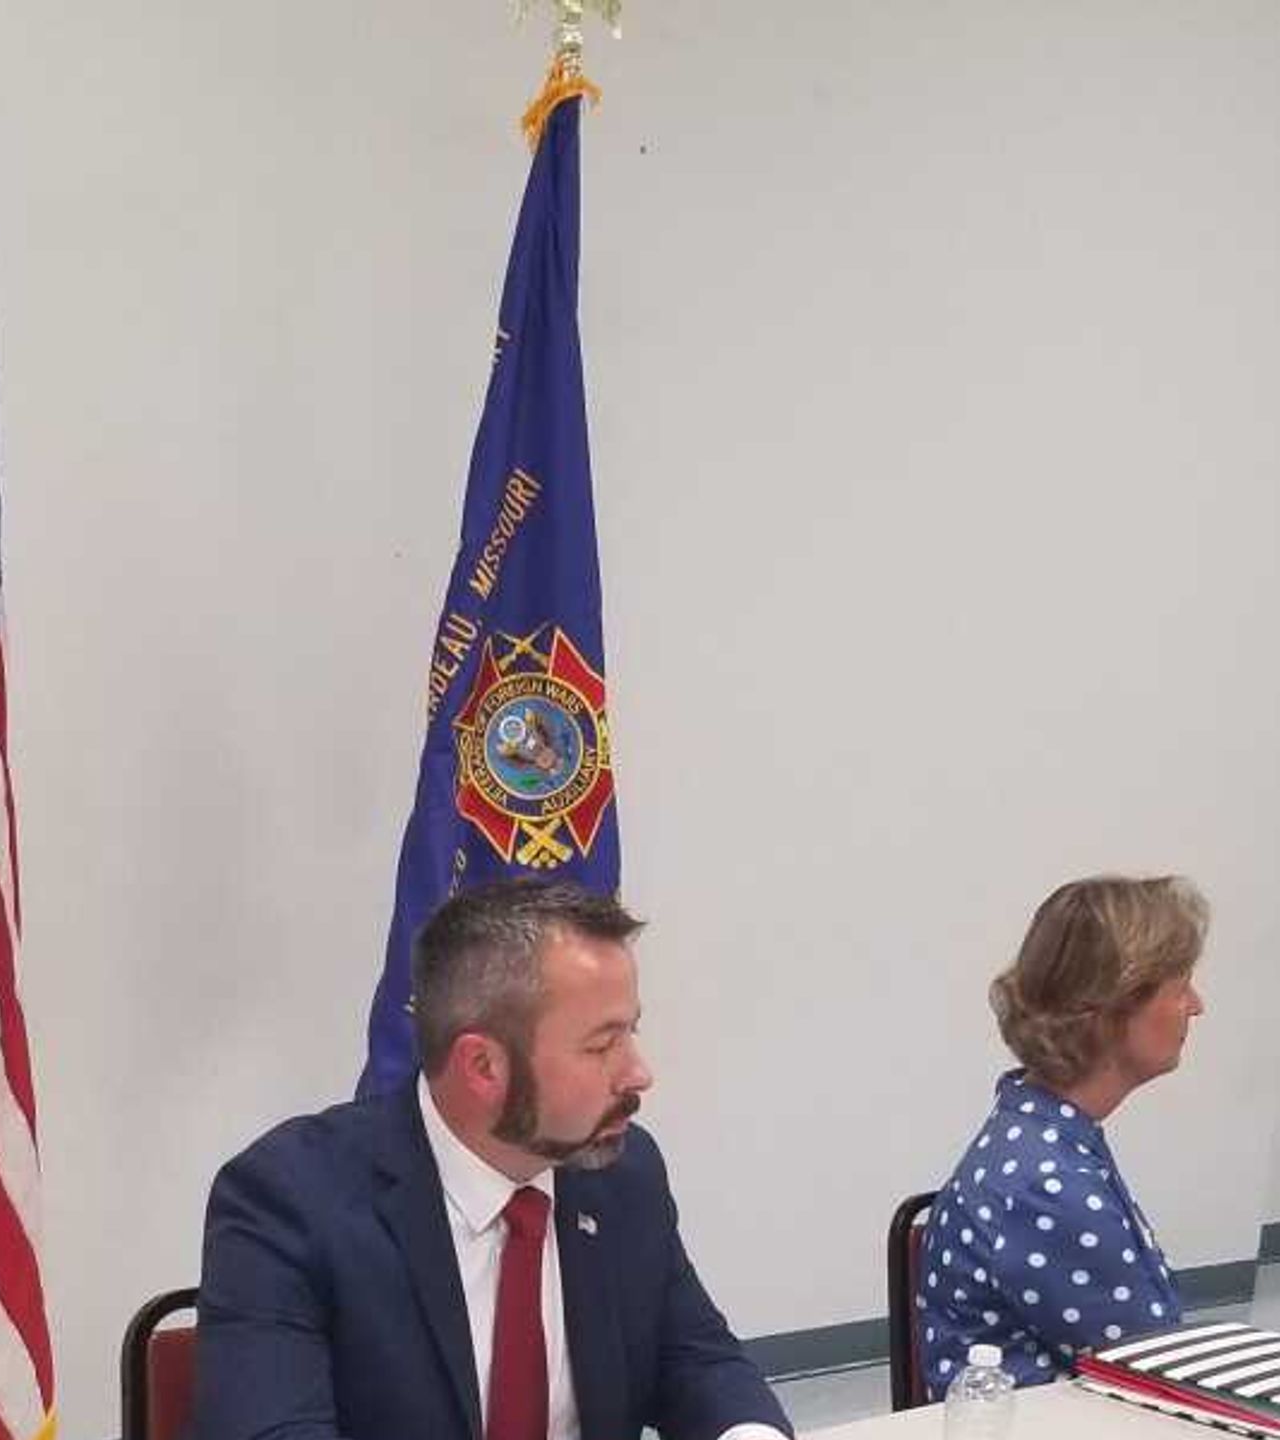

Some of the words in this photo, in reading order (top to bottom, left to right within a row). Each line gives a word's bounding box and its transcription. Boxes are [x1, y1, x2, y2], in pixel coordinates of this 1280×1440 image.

[470, 467, 543, 600] MISSOURI
[545, 680, 584, 715] WARS
[541, 747, 597, 815] AUXILIARY
